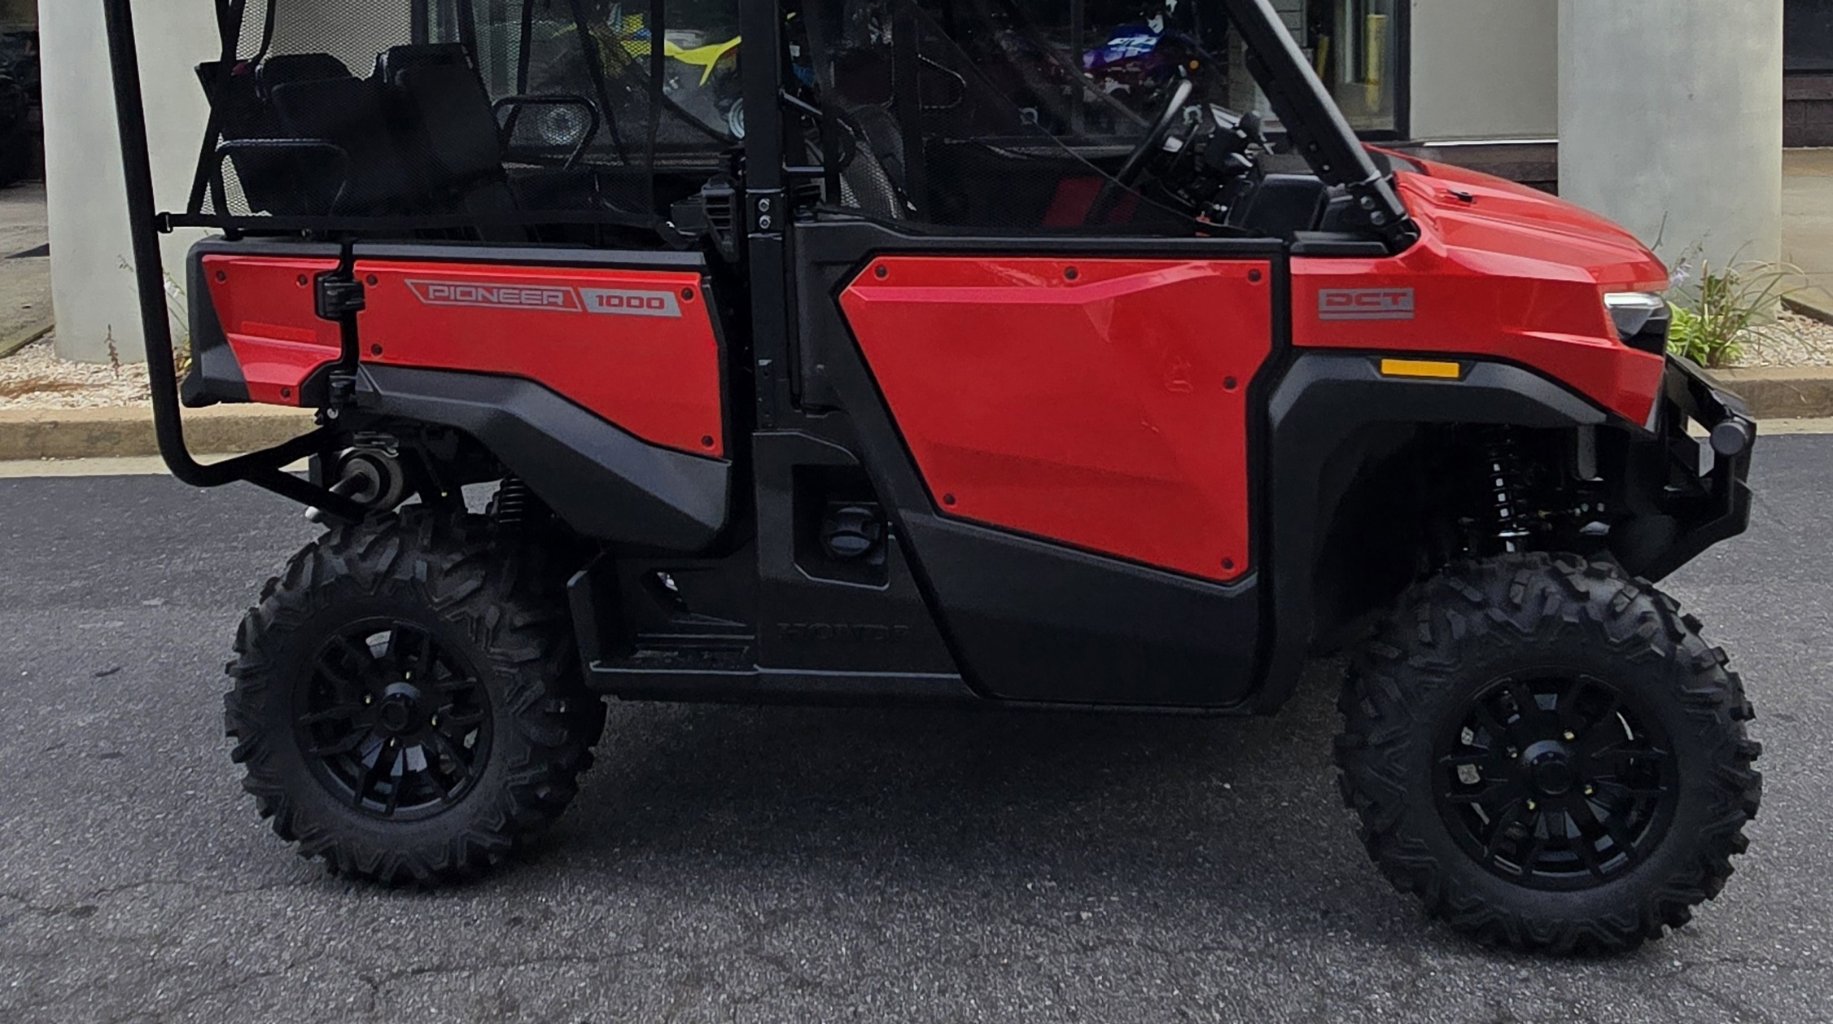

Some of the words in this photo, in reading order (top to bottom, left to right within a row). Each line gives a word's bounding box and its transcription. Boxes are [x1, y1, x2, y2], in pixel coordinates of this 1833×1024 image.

[428, 284, 565, 306] PIONEER
[595, 294, 666, 310] 1000
[1325, 291, 1408, 307] DCT
